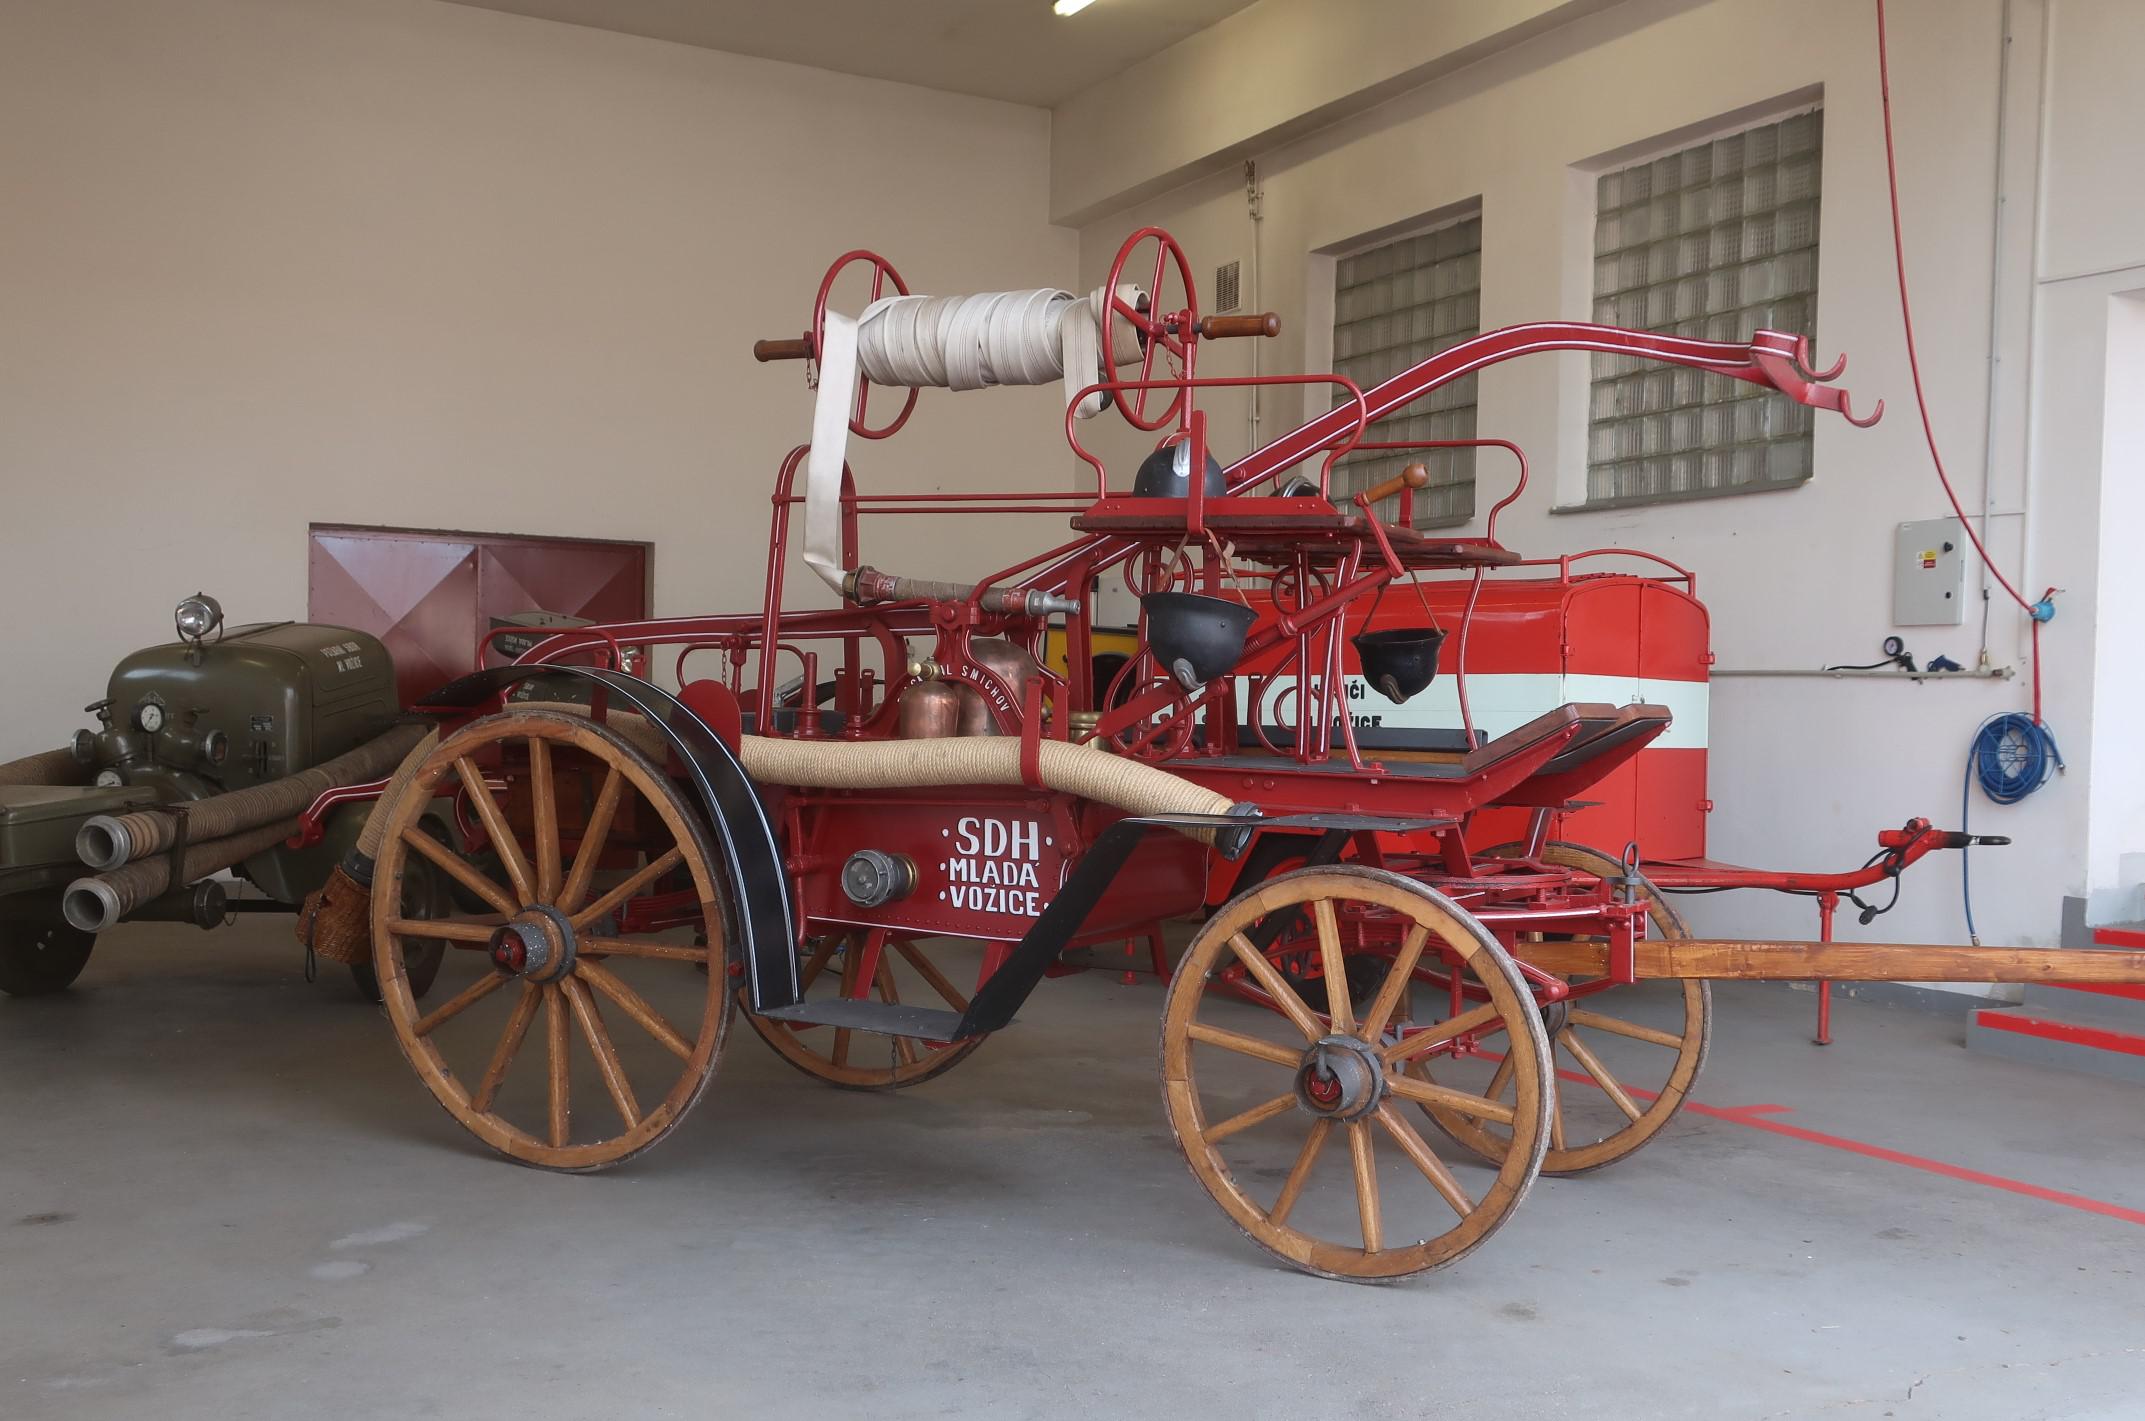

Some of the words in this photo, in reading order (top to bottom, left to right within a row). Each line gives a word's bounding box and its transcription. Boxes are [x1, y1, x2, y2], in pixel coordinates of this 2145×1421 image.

[961, 665, 1010, 712] SMICHOV
[956, 817, 1039, 861] SDH
[949, 857, 1040, 888] MLADÁ
[950, 885, 1040, 917] VOŽICE
